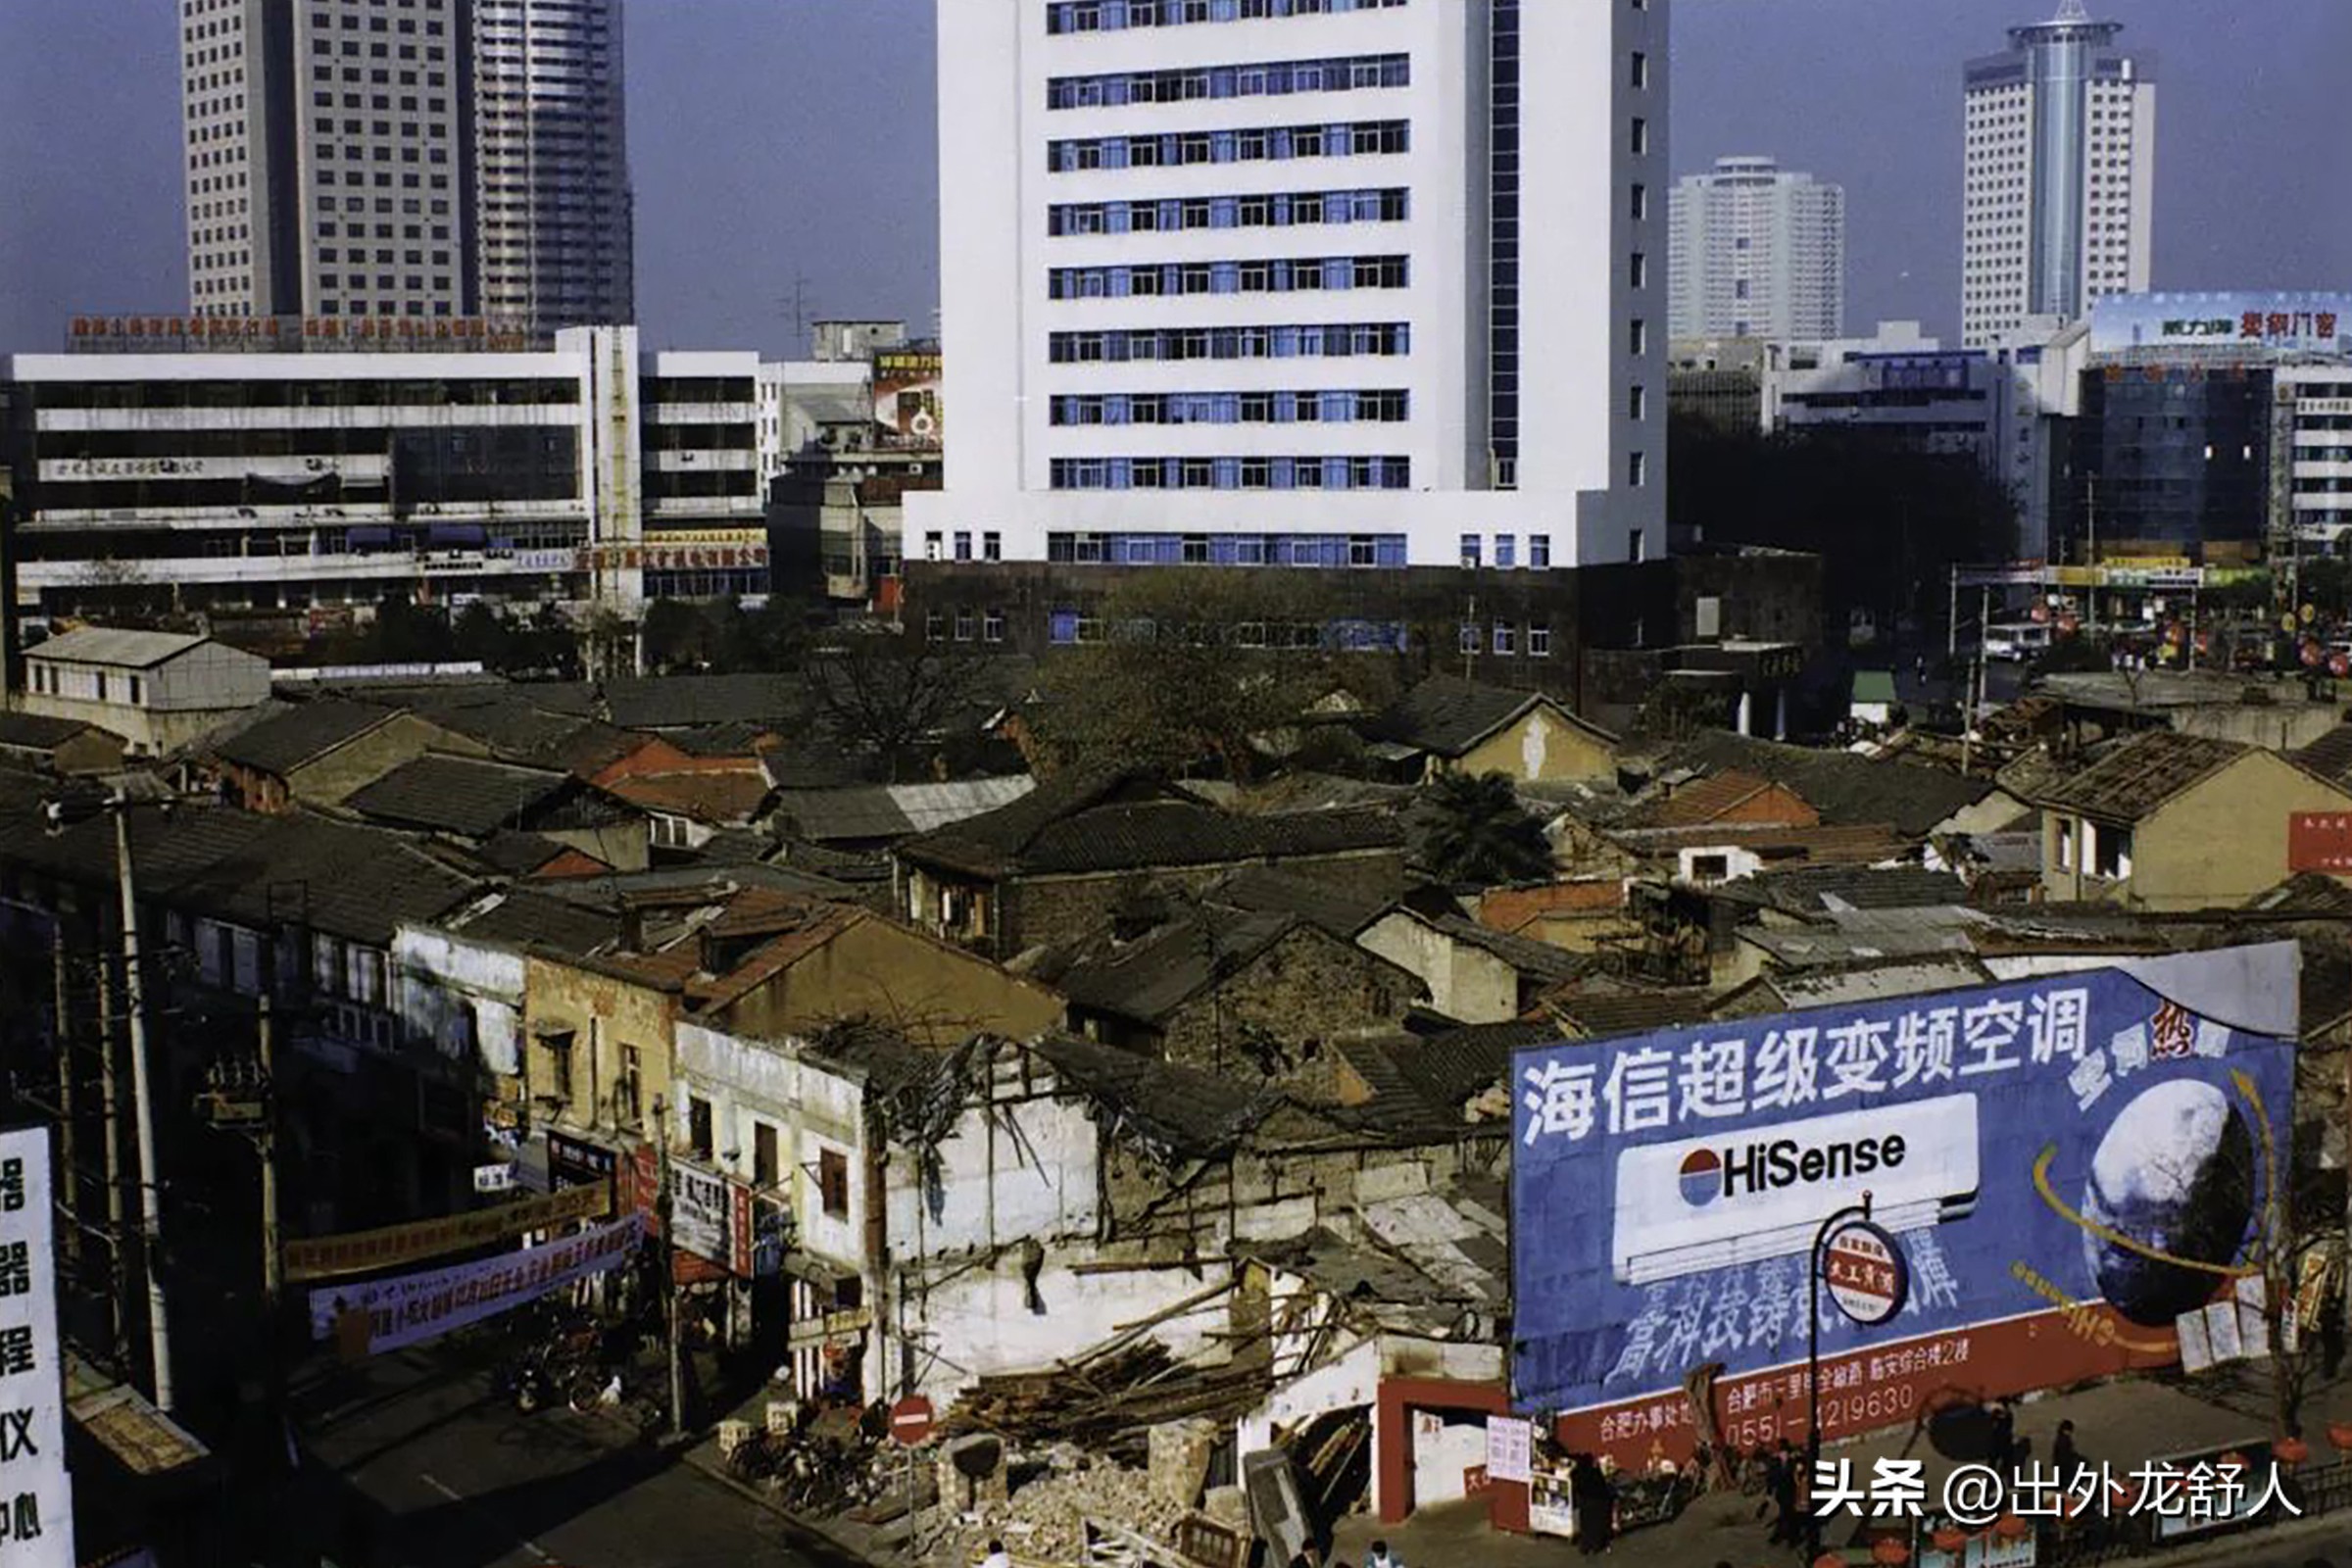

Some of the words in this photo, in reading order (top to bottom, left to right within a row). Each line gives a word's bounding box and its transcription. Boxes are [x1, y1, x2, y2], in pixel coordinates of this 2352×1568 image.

[1524, 989, 2089, 1146] 海信超级变频空调
[1723, 1133, 1905, 1199] HiSense
